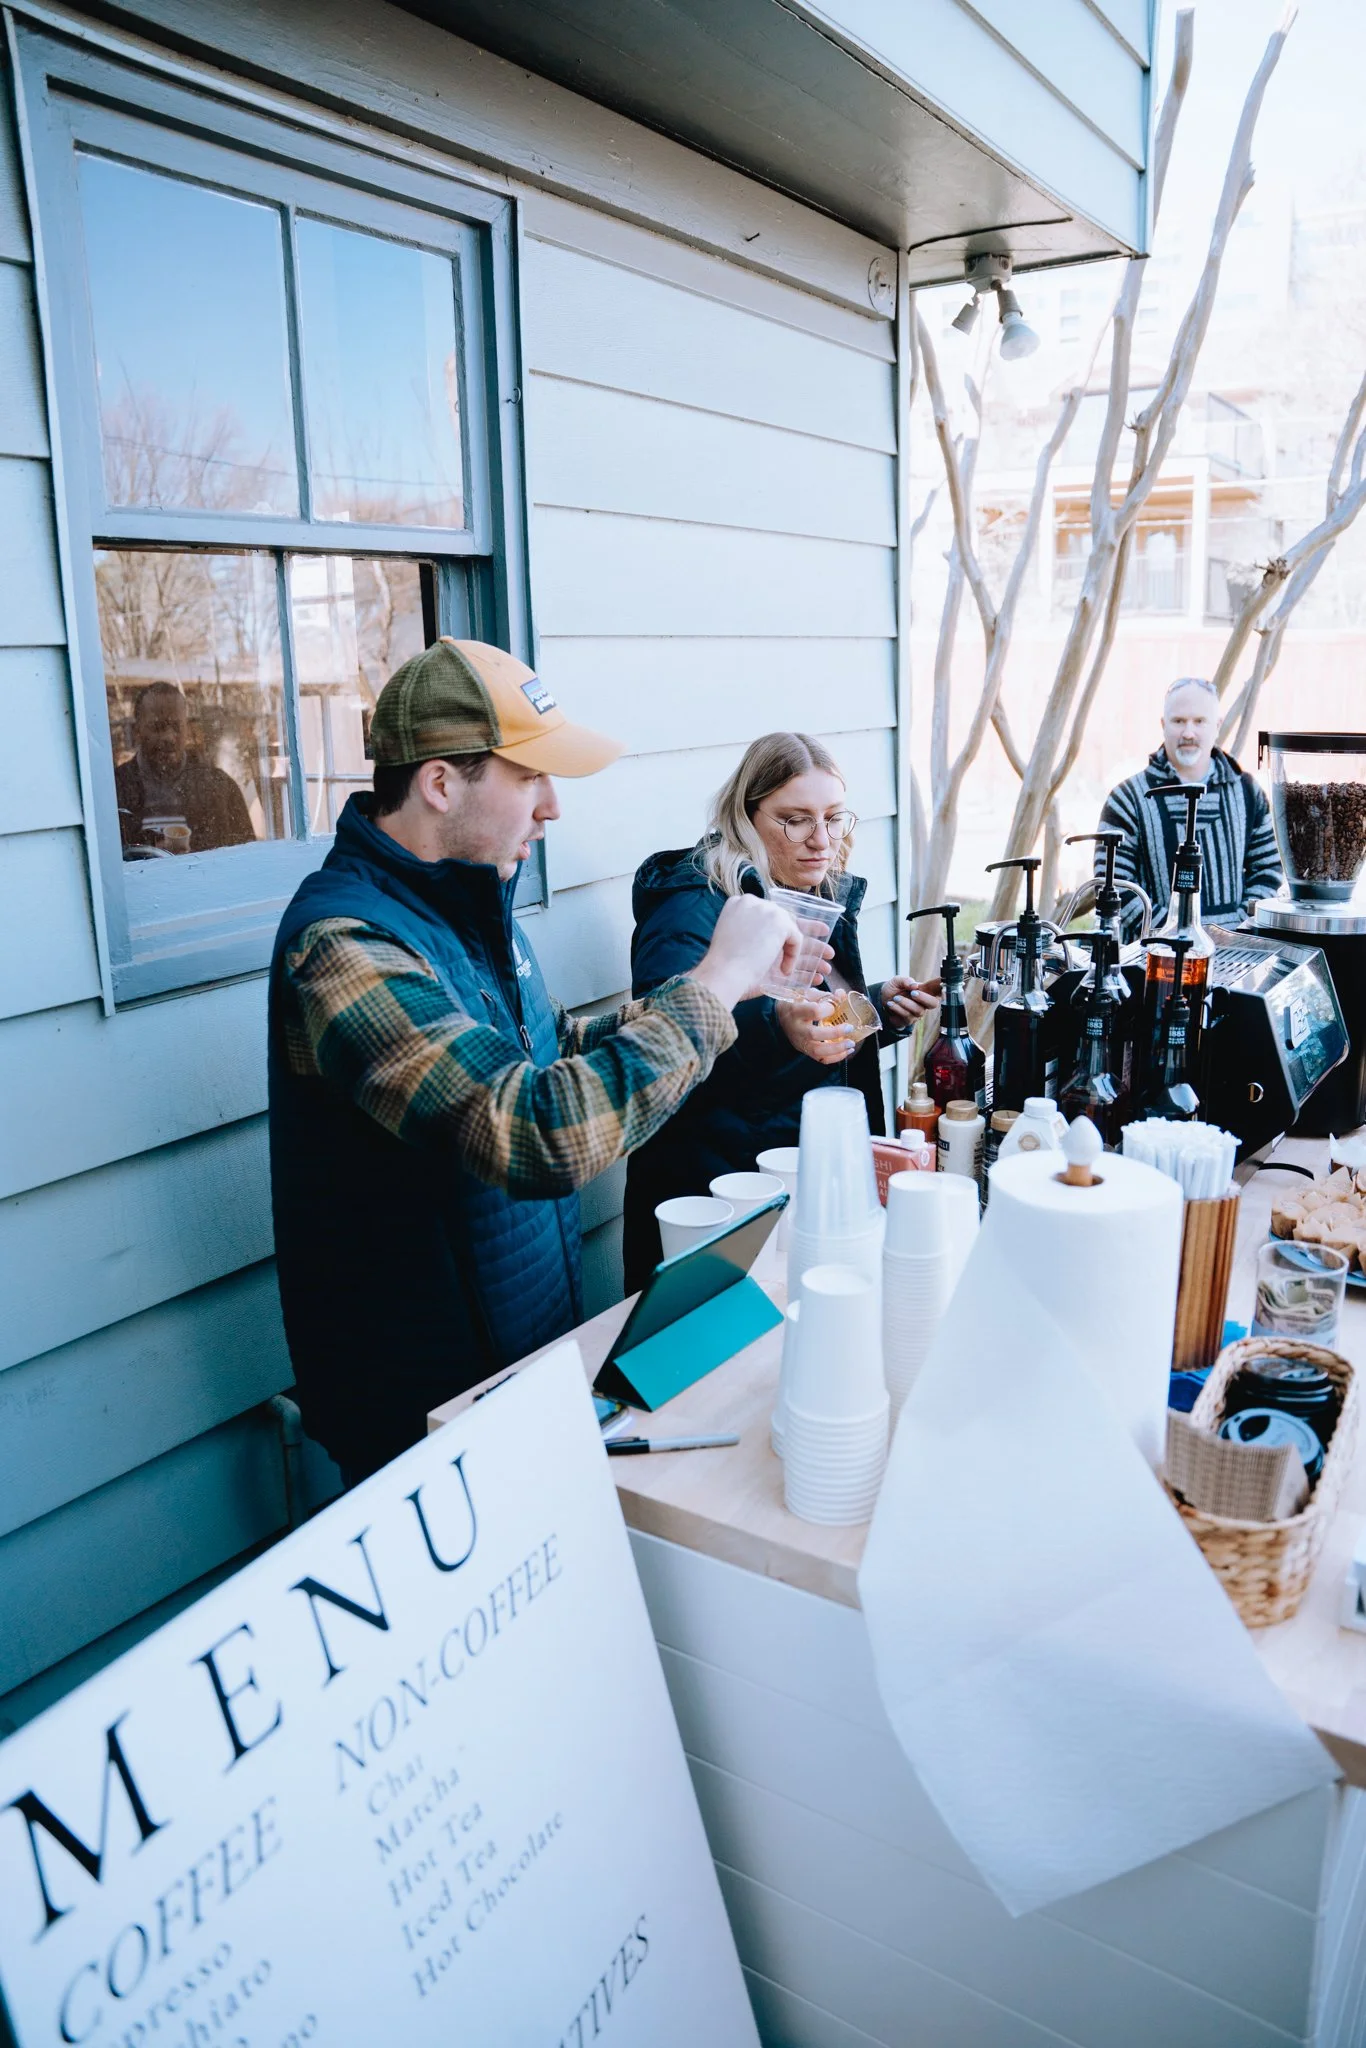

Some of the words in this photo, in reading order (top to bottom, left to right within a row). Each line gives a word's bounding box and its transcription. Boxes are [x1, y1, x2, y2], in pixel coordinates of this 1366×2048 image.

[1177, 873, 1194, 881] 1883
[0, 1449, 480, 1945] MENU
[334, 1532, 563, 1793] NON-COFFEE
[367, 1754, 424, 1816] Chai
[375, 1767, 460, 1866] Matcha
[388, 1848, 437, 1908] Hot
[441, 1802, 483, 1848] Tea
[401, 1877, 452, 1952] Iced
[455, 1840, 497, 1886] Tea
[412, 1934, 461, 1999] Hot
[465, 1811, 563, 1932] Chocolate
[58, 1796, 282, 2043] COFFEE
[108, 1943, 232, 2048] presso
[174, 1959, 272, 2048] hiato
[556, 1912, 648, 2048] TIVES
